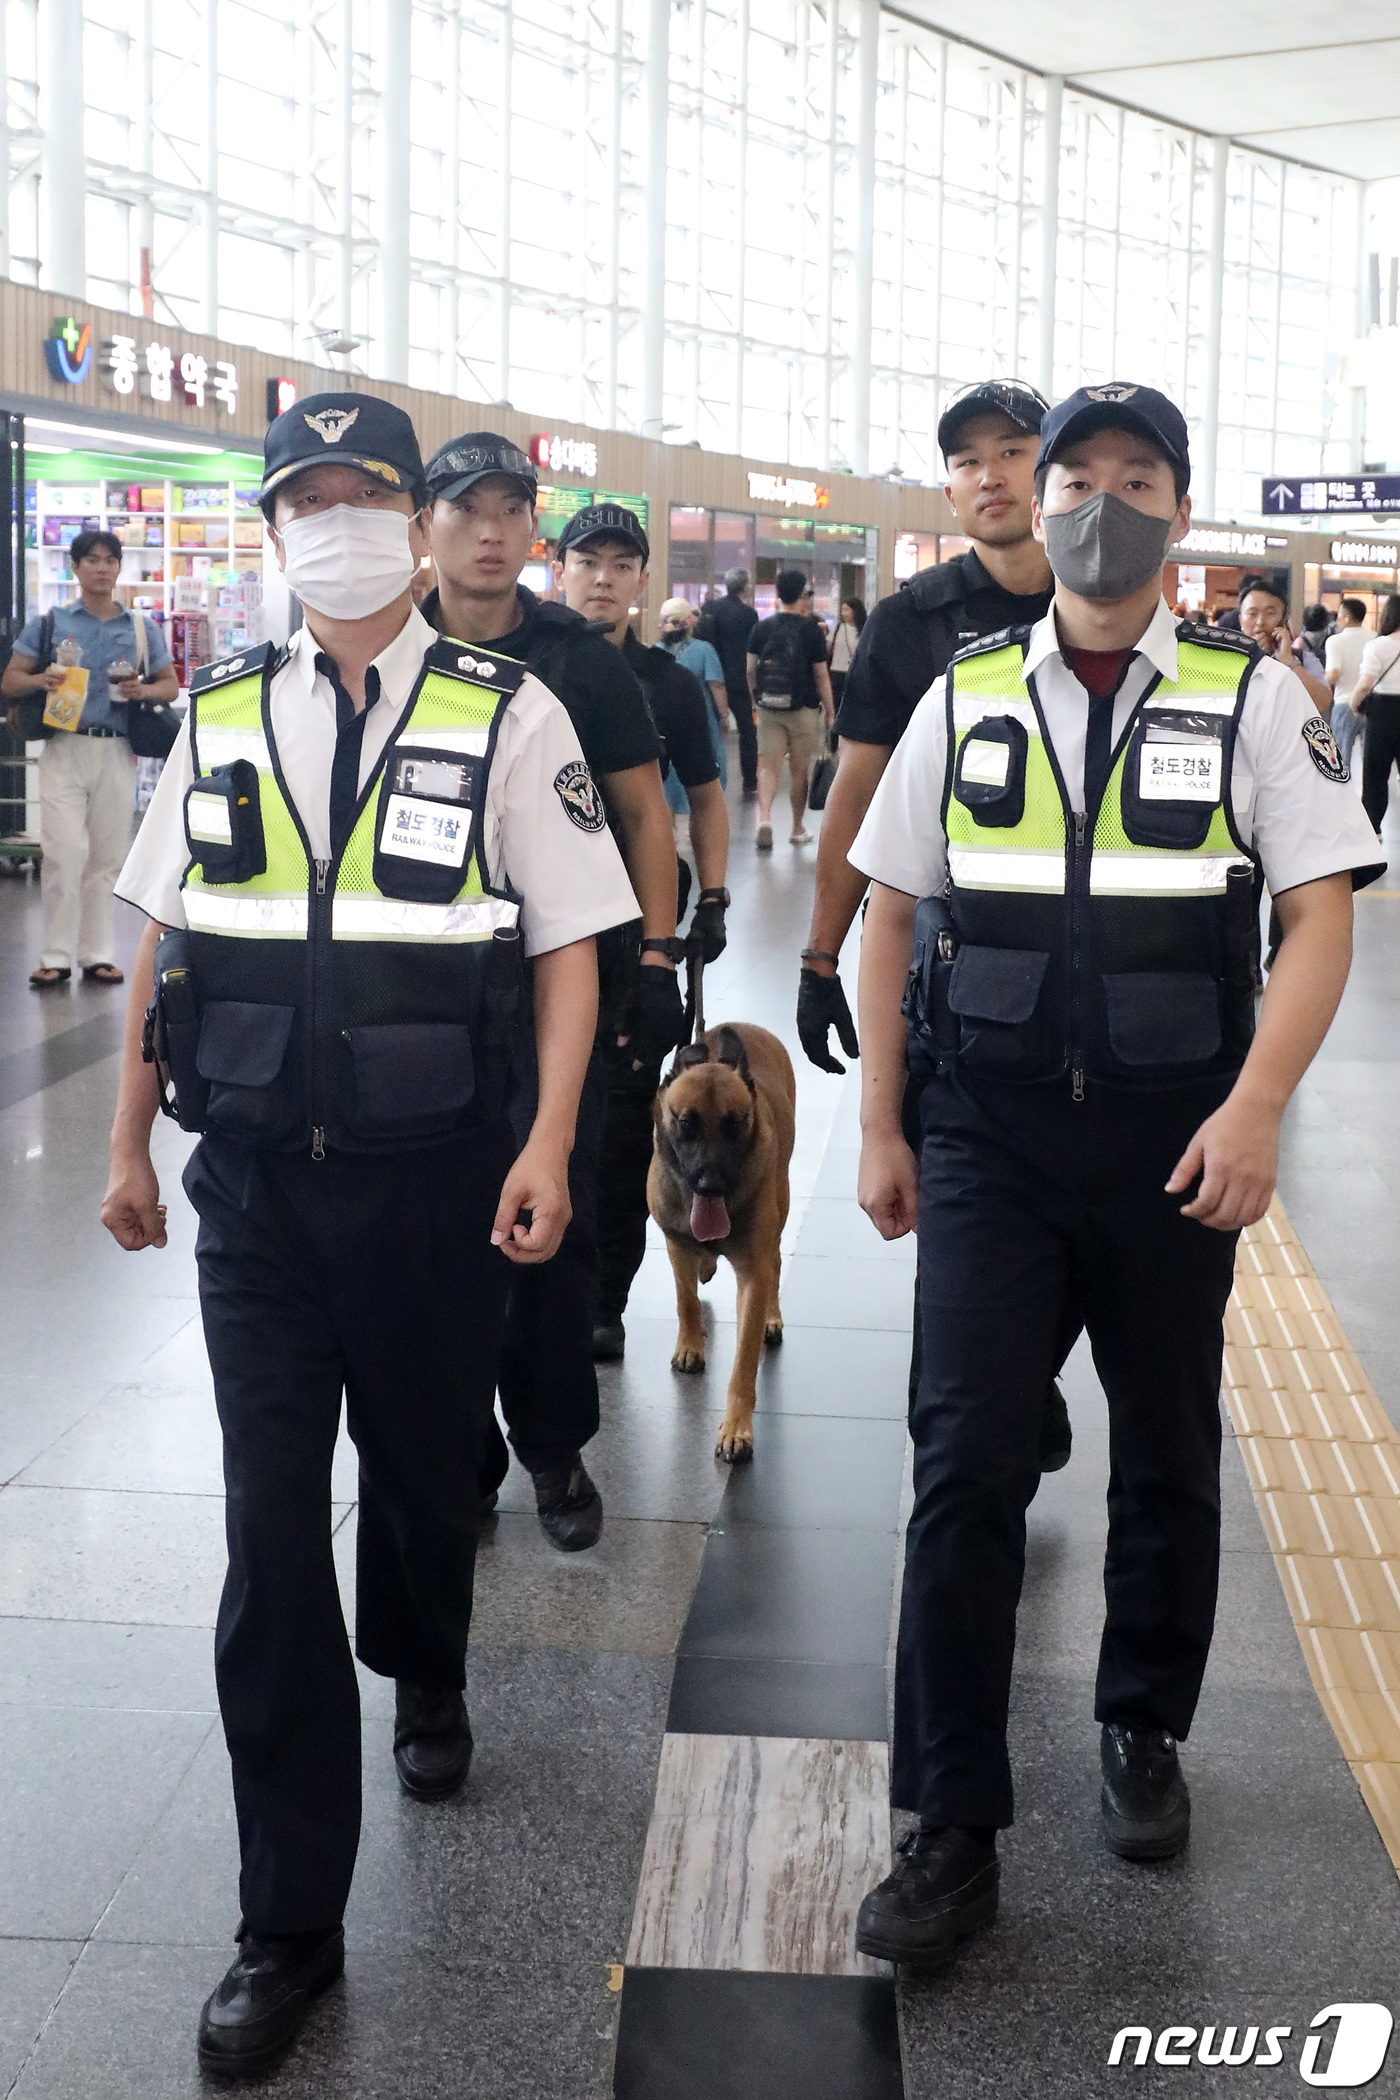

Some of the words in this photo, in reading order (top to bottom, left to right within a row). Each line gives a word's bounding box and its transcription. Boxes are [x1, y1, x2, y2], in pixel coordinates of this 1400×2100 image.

[109, 334, 238, 415] 종합약국
[1328, 482, 1356, 499] 타는
[1361, 481, 1376, 499] 곳
[1328, 499, 1364, 509] Platforms
[1231, 532, 1266, 556] PLACE
[1150, 756, 1212, 776] 철도경찰
[396, 809, 461, 840] 철도경찰
[391, 833, 428, 847] RAILWAY
